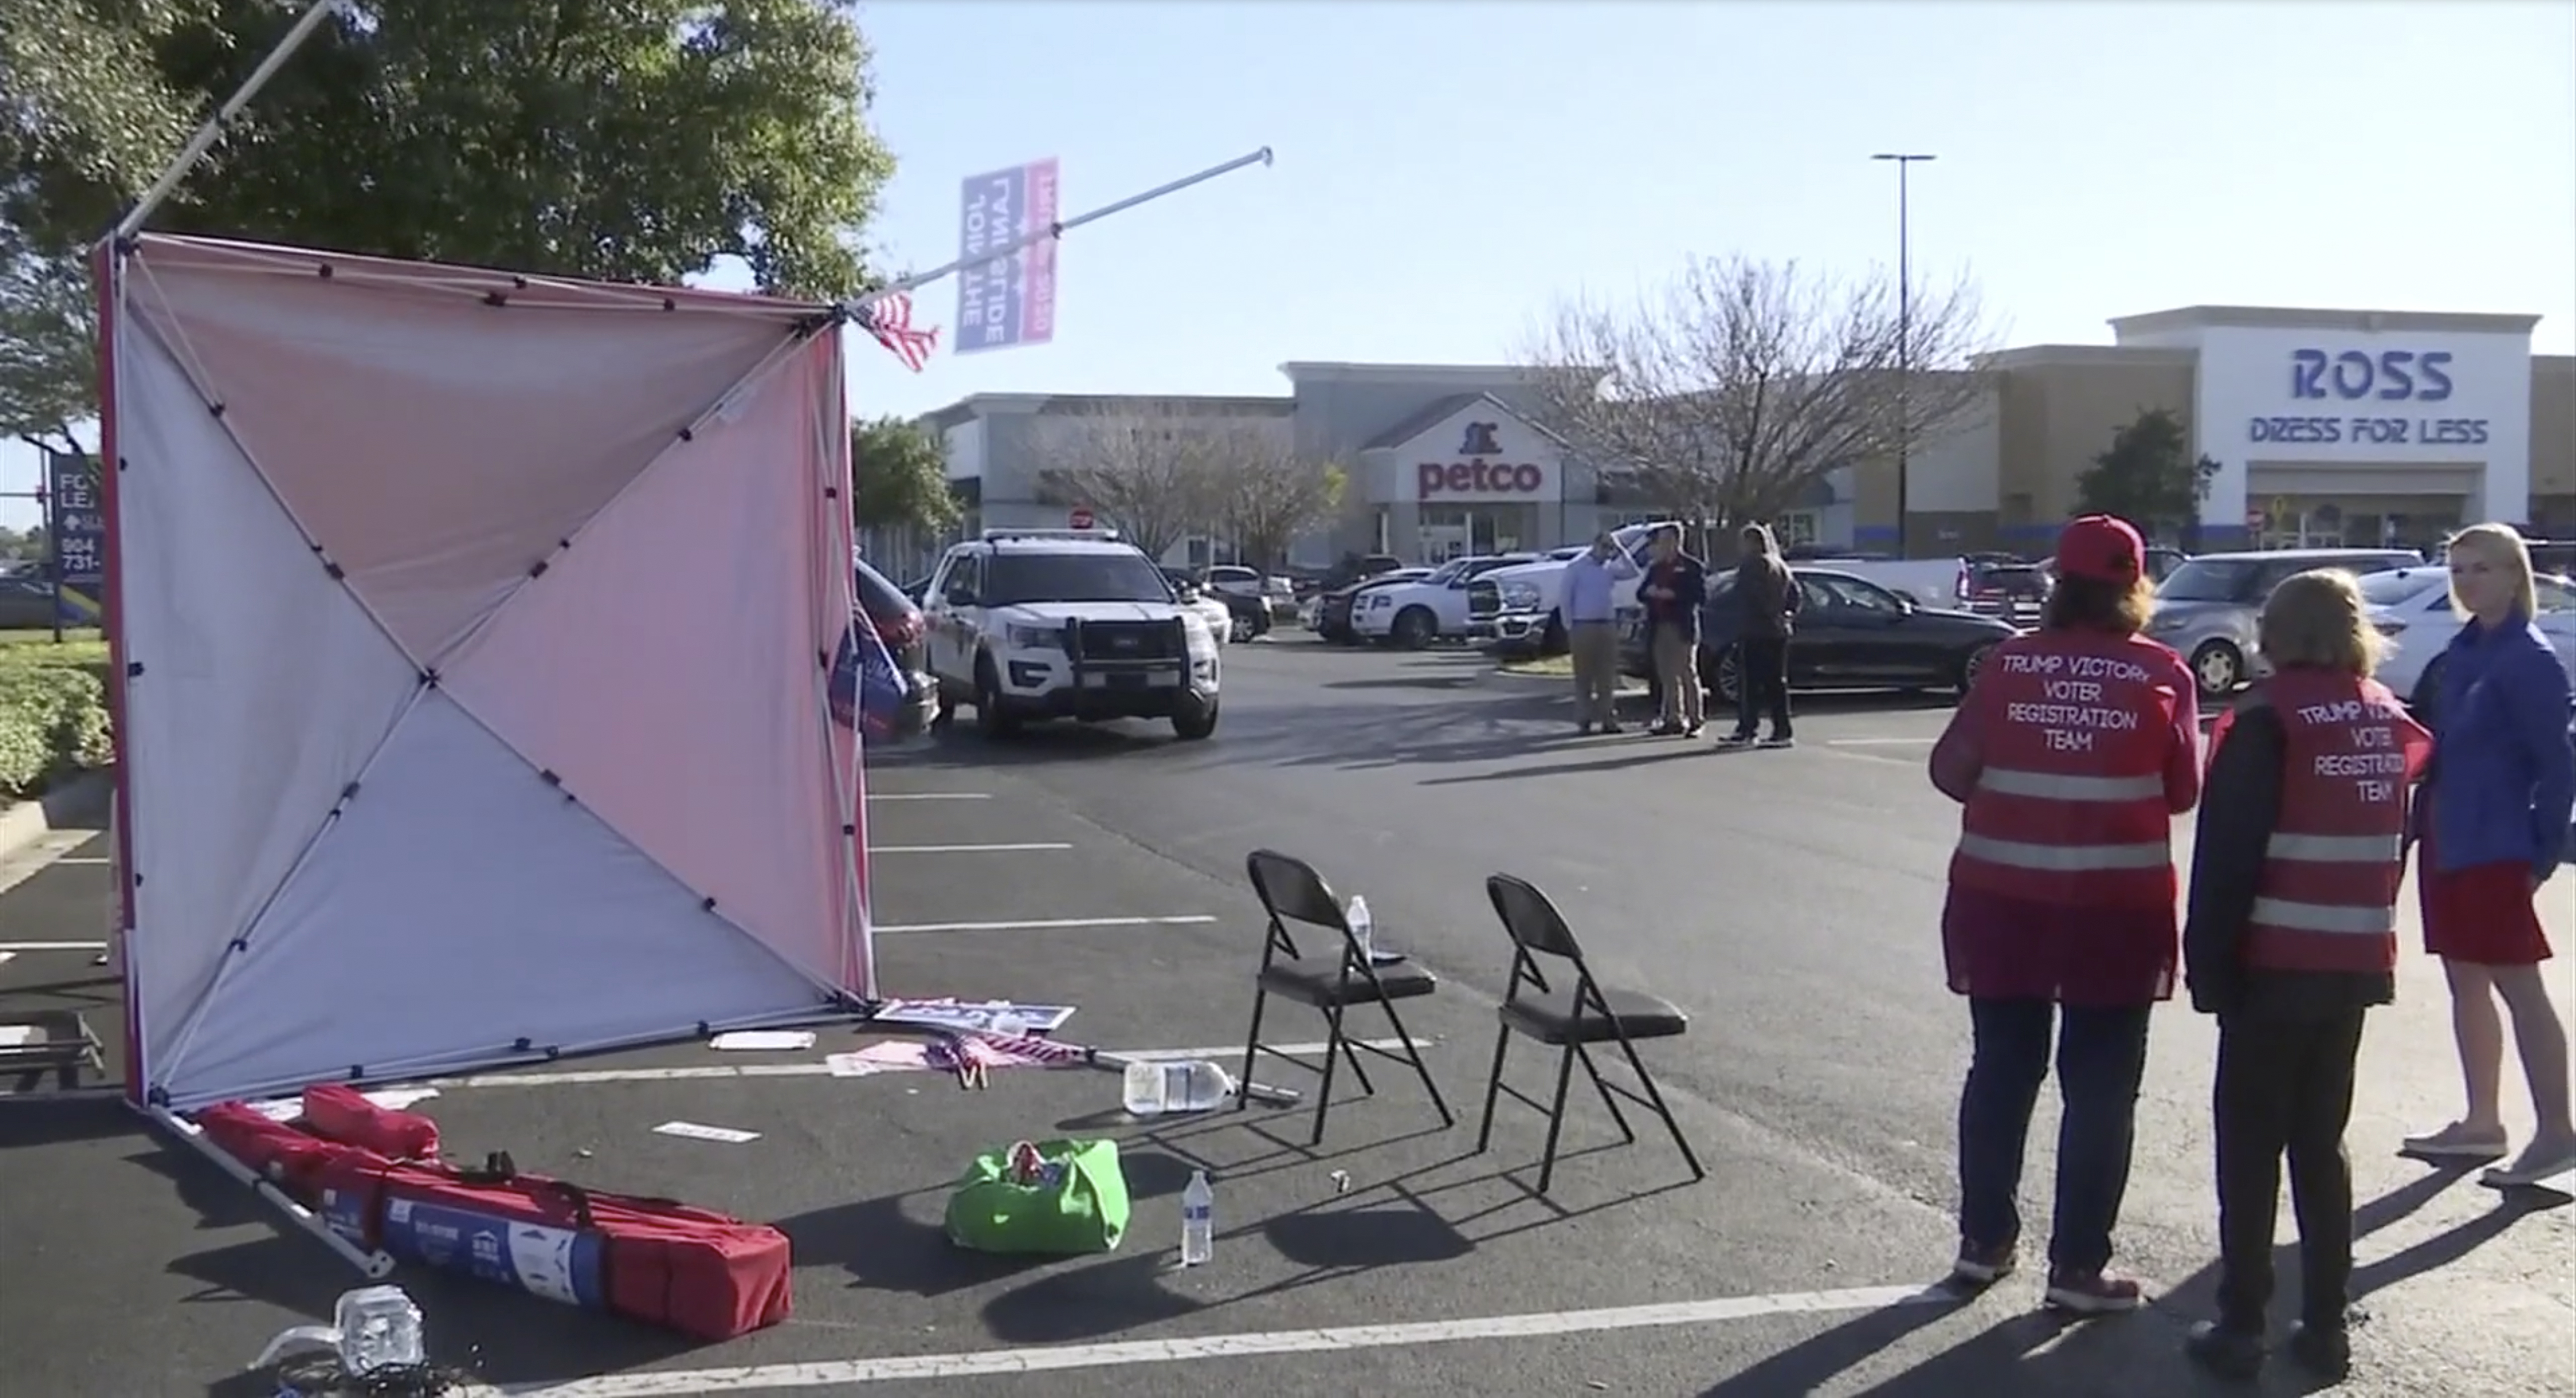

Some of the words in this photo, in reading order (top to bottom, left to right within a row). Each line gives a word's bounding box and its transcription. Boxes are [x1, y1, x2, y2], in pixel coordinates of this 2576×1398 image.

[2292, 349, 2453, 401] ROSS
[2250, 417, 2341, 443] DRESS
[2351, 418, 2409, 444] FOR
[2419, 419, 2488, 444] LESS
[1418, 458, 1542, 499] petco
[2003, 655, 2063, 673] TRUMP
[2068, 656, 2150, 681] VICTORY
[2043, 680, 2102, 701] VOTER
[2007, 703, 2138, 729] REGISTRATION
[2297, 700, 2362, 724] TRUMP
[2044, 729, 2092, 750] TEAM
[2351, 726, 2393, 747] VOTE
